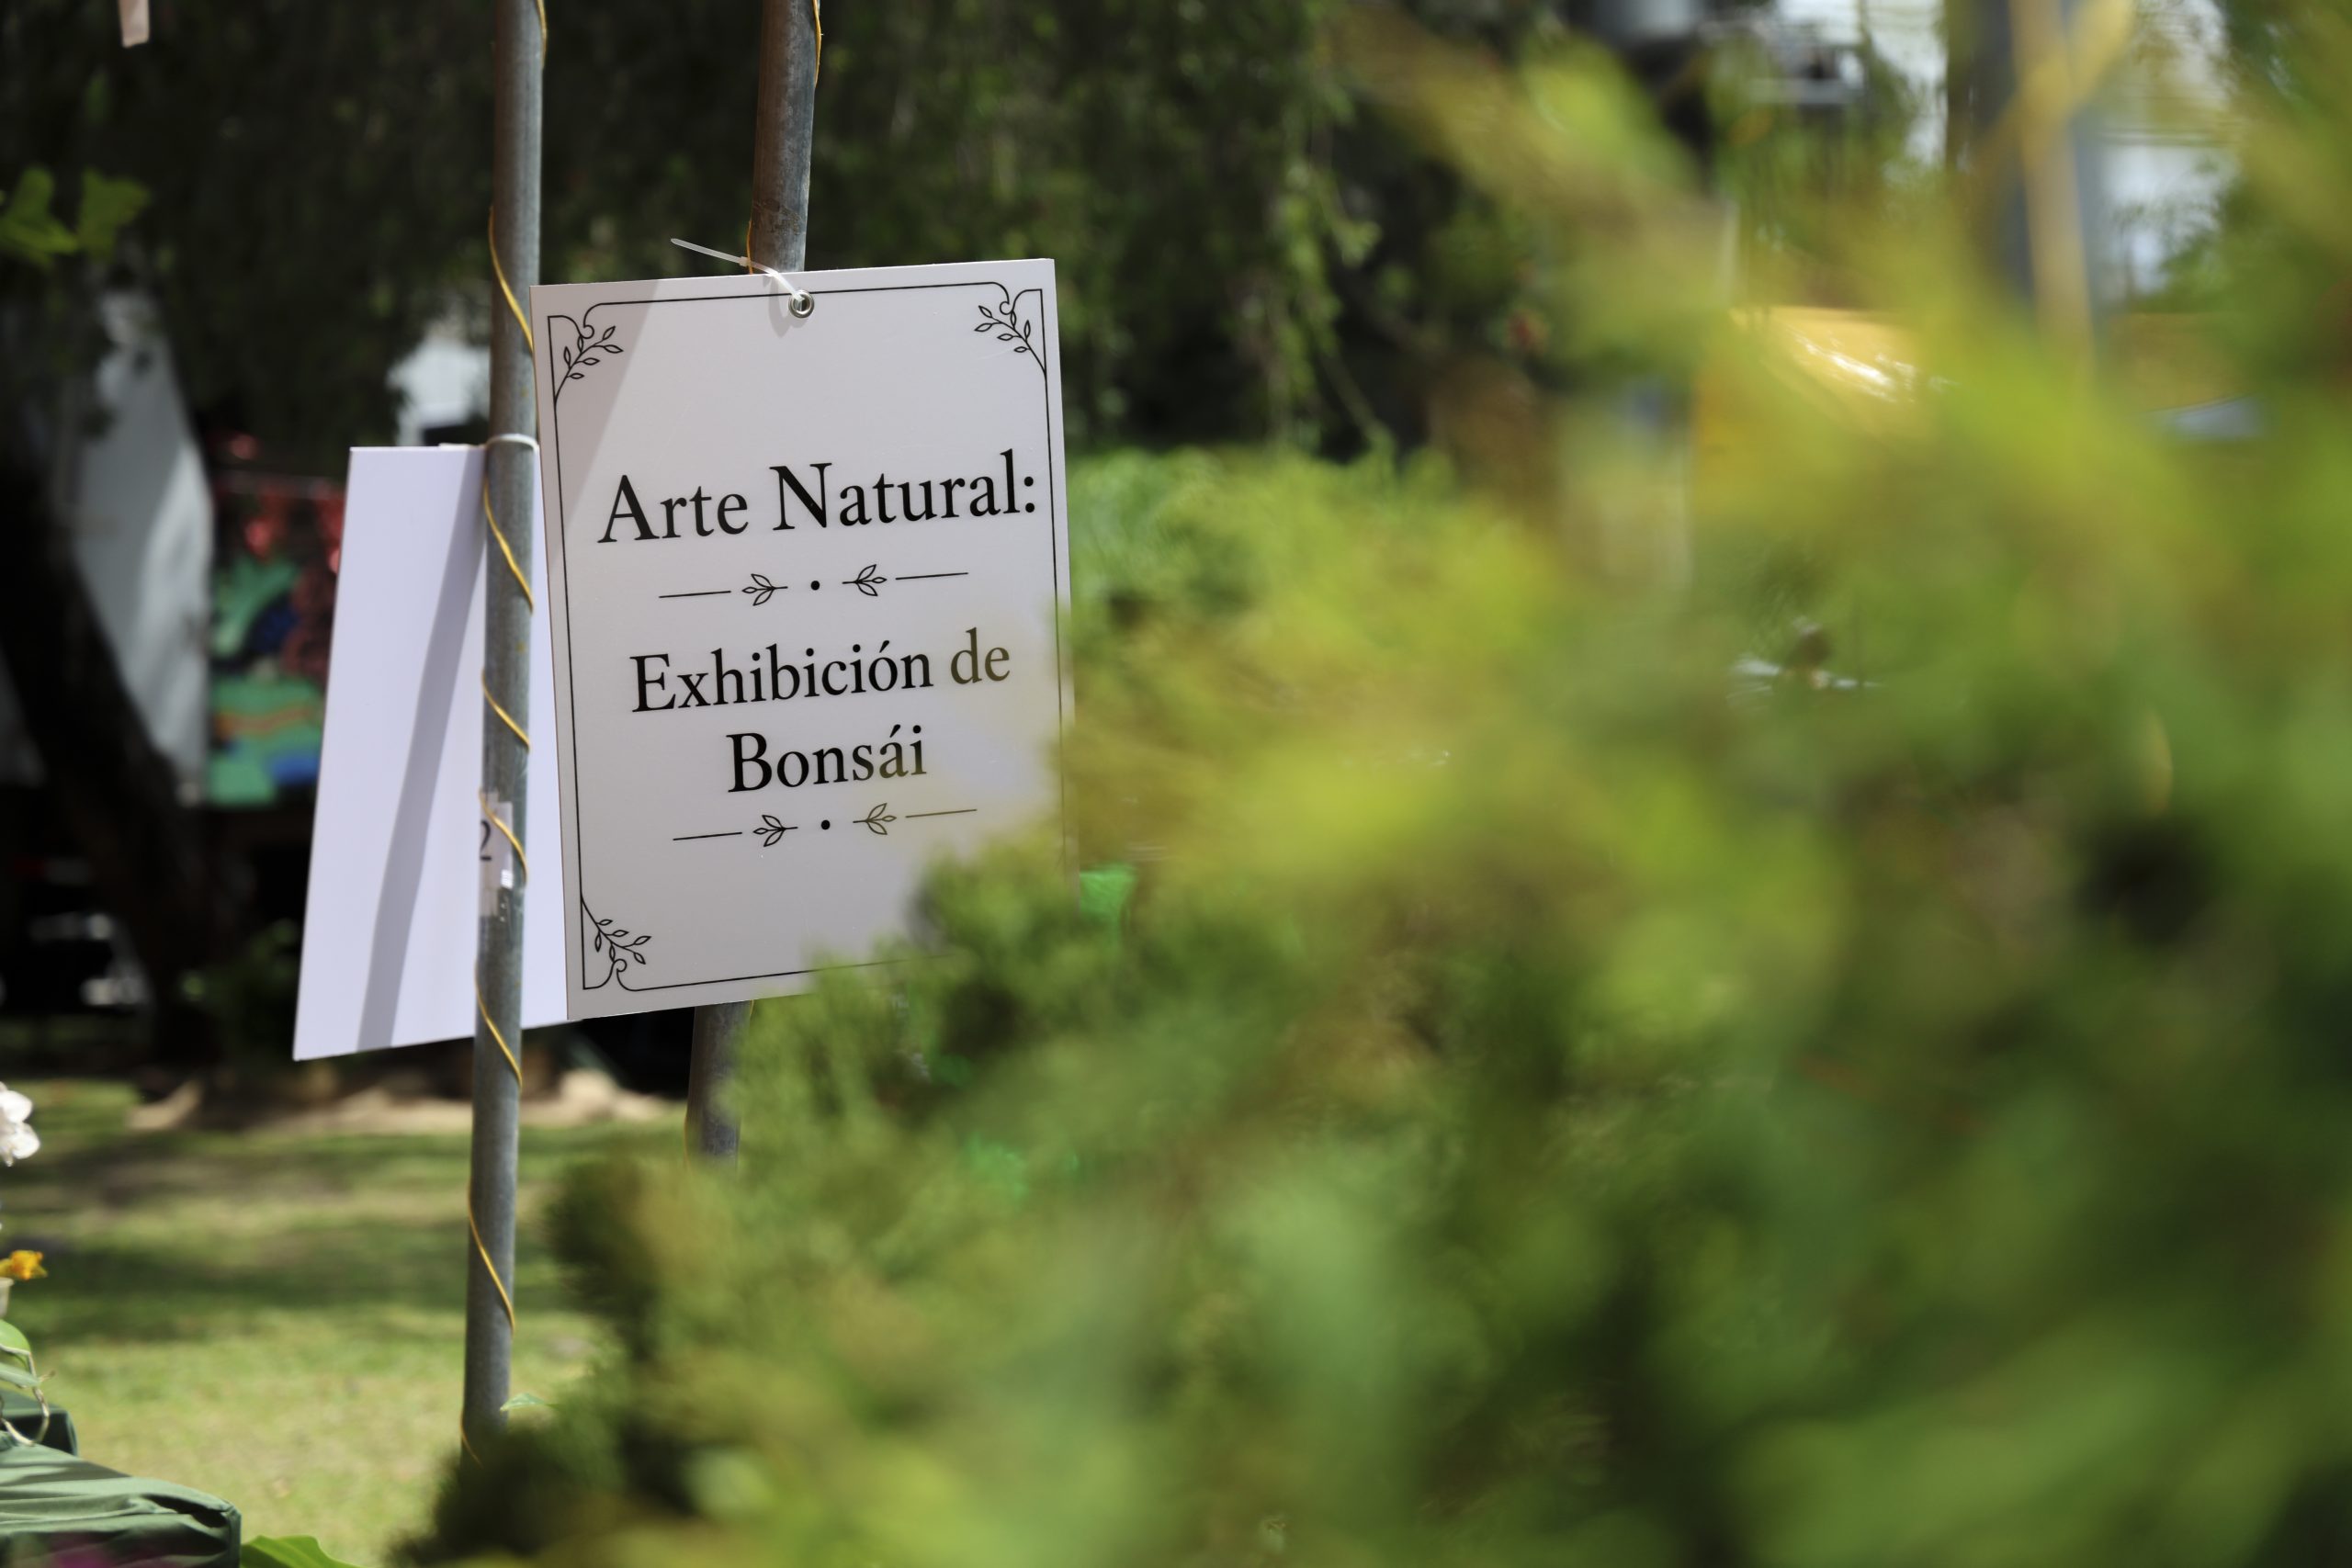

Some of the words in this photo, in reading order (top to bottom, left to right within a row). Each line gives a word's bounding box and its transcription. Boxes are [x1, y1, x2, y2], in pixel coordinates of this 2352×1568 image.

[597, 474, 749, 544] Arte
[769, 448, 1036, 531] Natural:
[629, 639, 934, 713] Exhibición
[950, 626, 1012, 685] de
[725, 724, 928, 794] Bonsái
